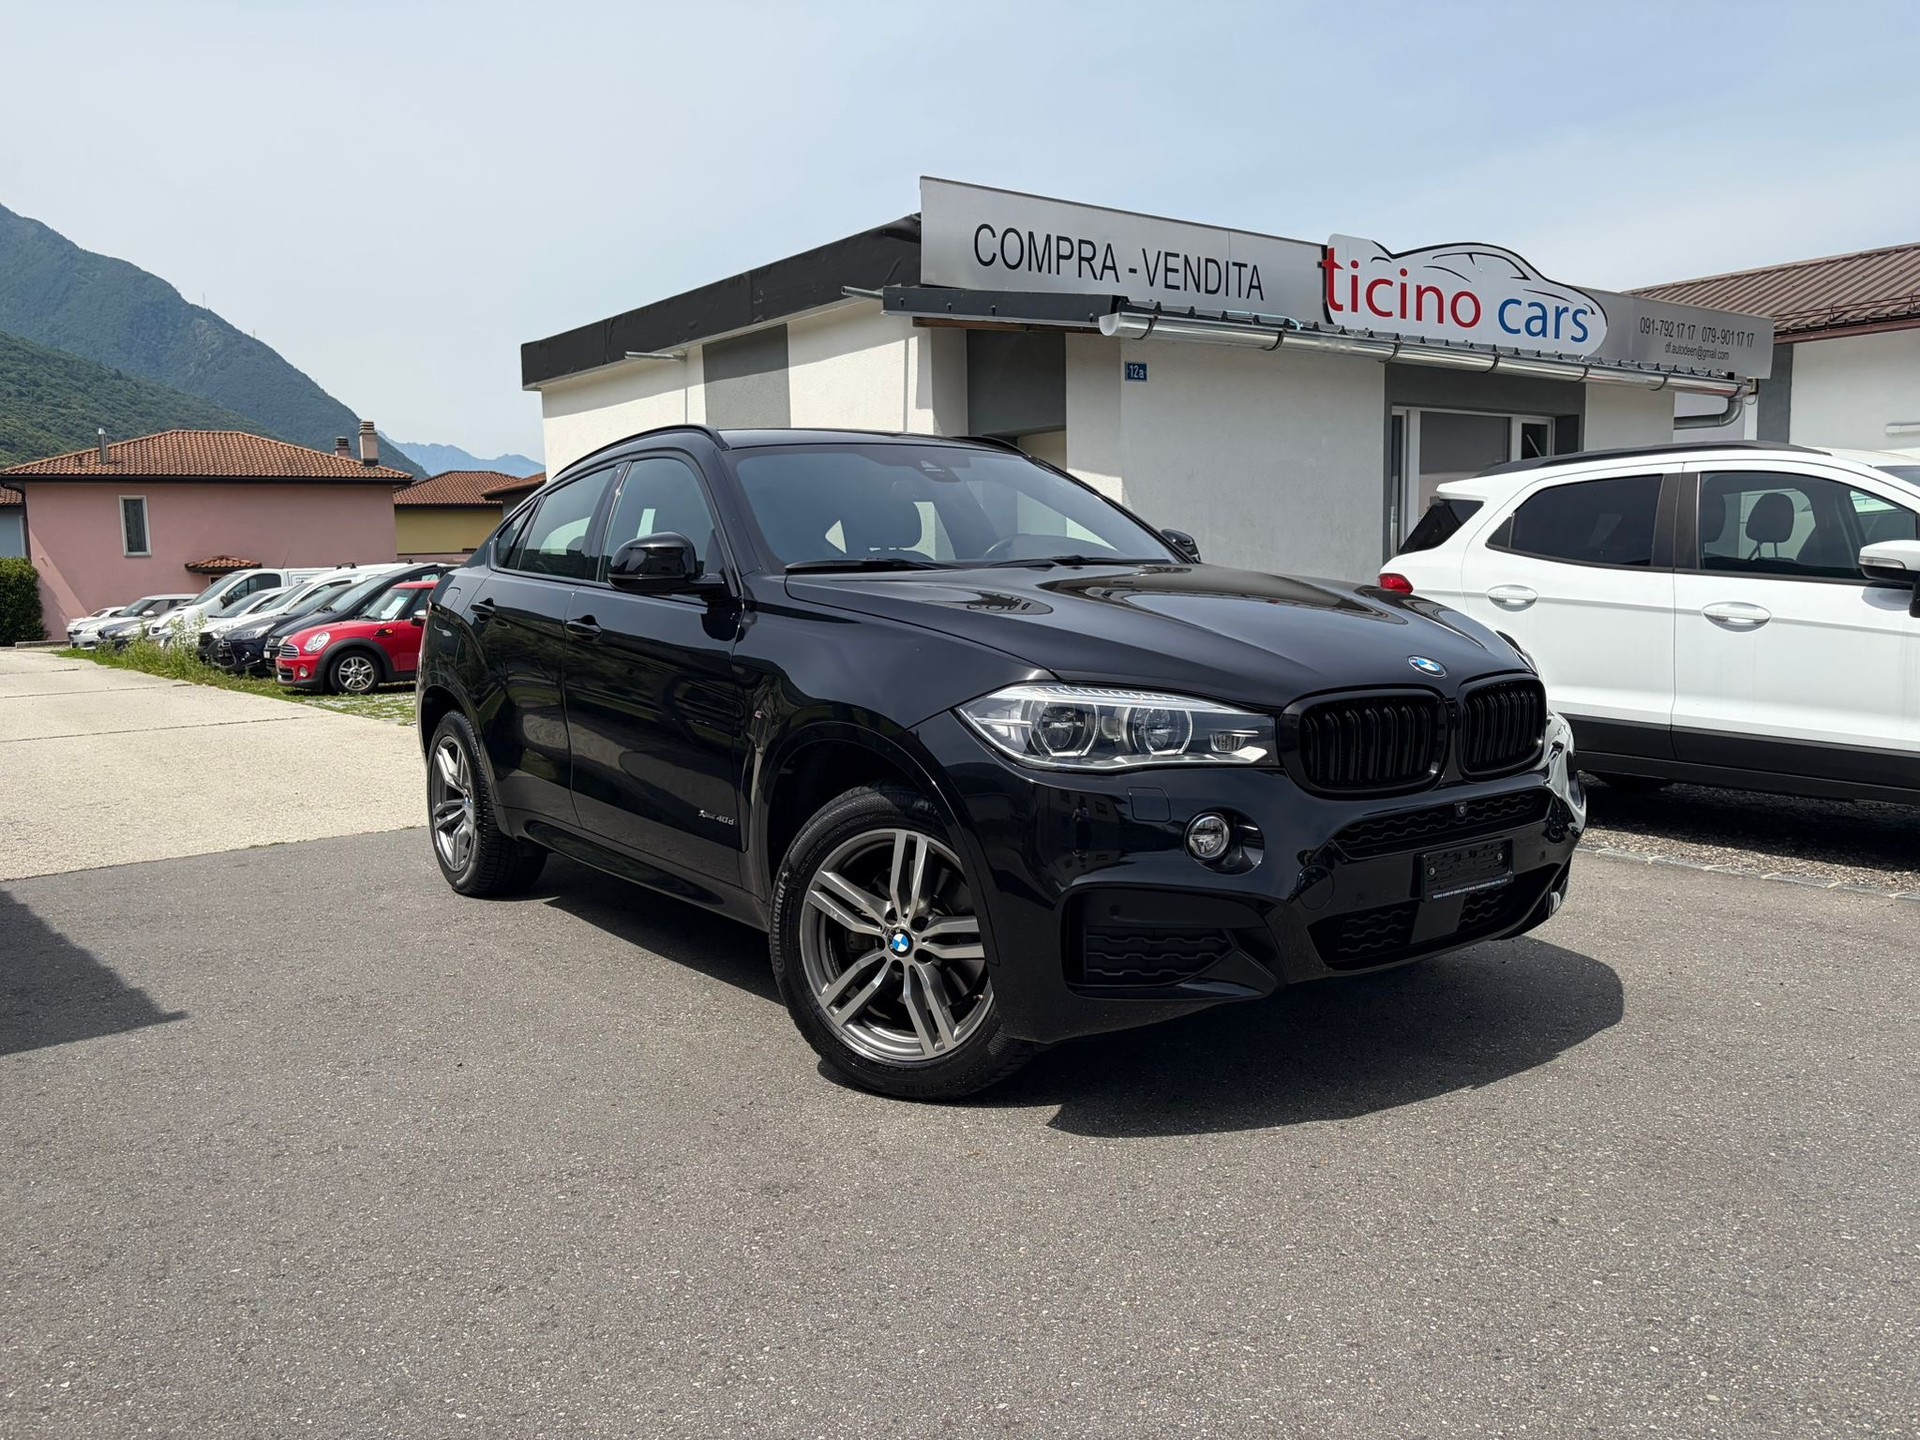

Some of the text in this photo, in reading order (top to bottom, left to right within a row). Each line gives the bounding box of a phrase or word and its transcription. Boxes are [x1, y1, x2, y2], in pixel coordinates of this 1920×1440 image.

[973, 223, 1120, 283] COMPRA
[1141, 247, 1265, 301] VENDITA
[1322, 246, 1590, 343] ticino cars
[1640, 316, 1755, 348] 091-792 17 17 079-901 17 17
[1129, 365, 1145, 379] 12a
